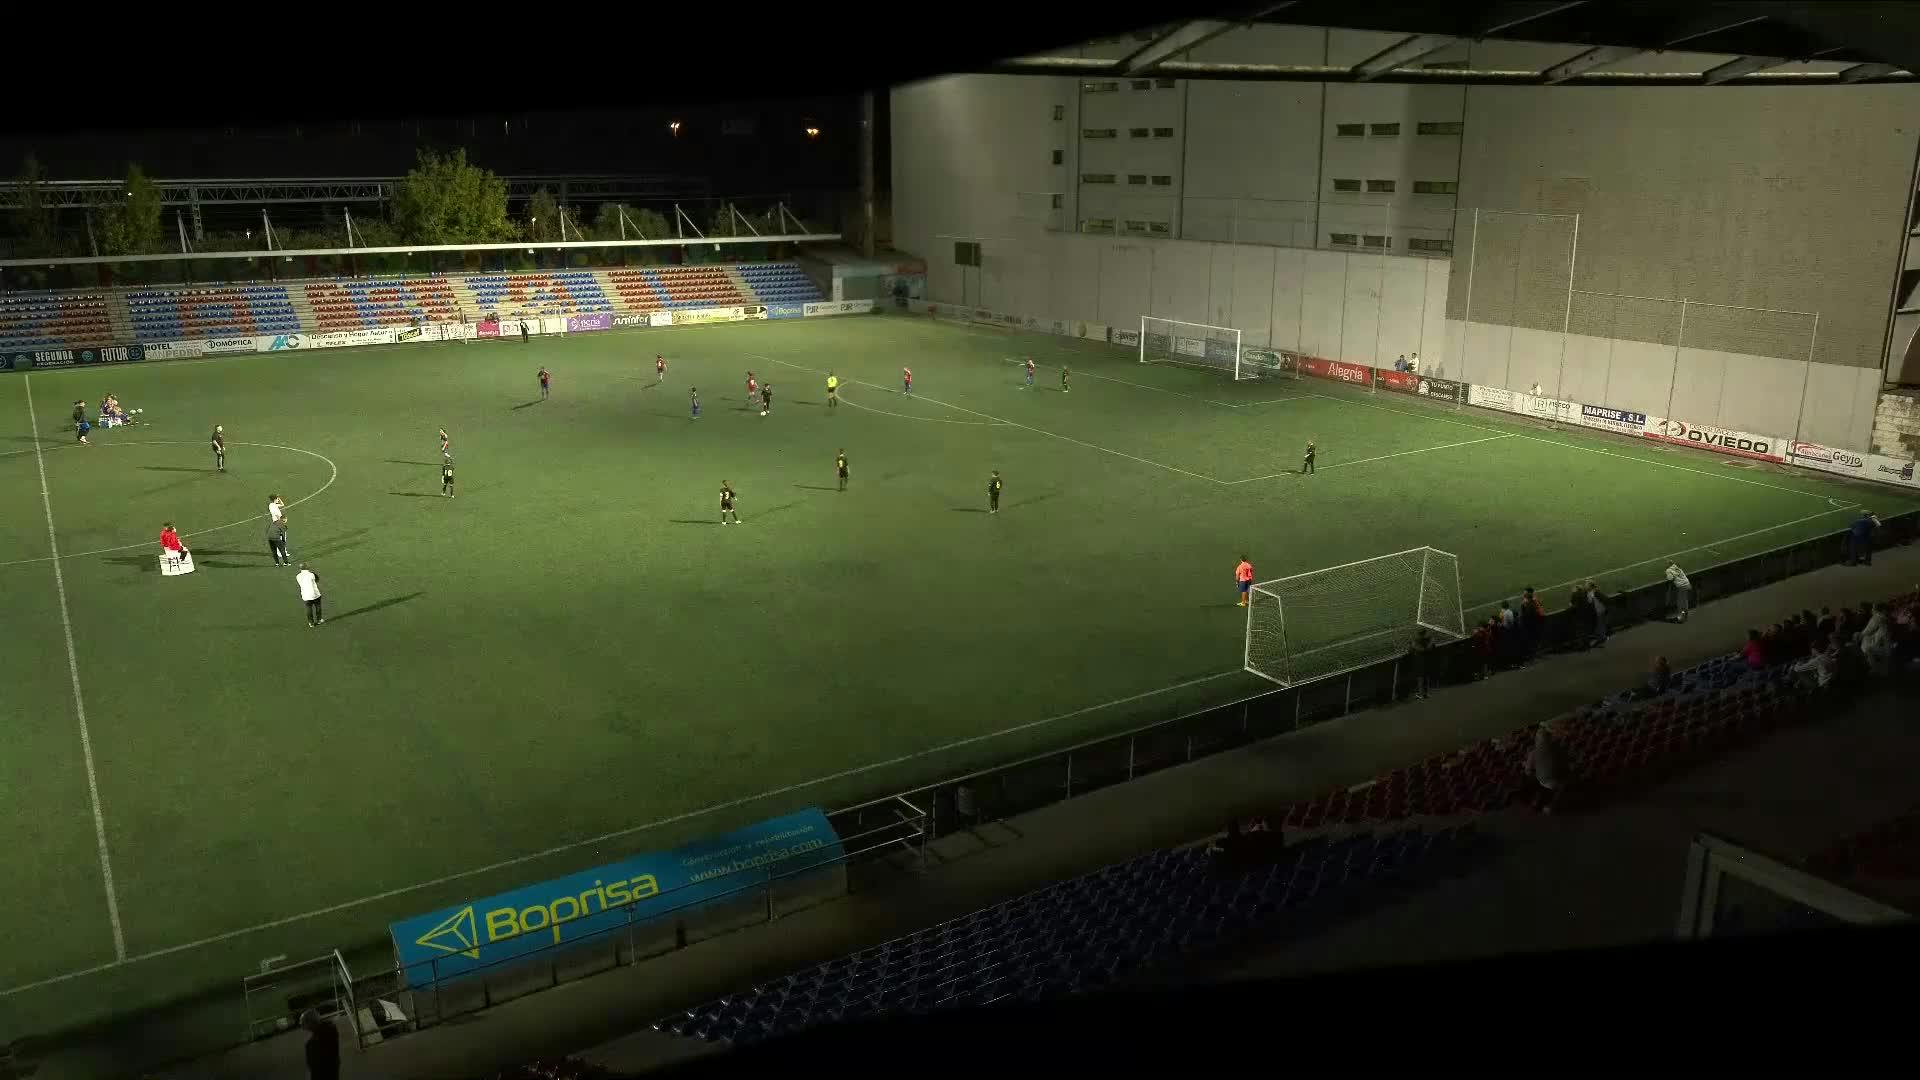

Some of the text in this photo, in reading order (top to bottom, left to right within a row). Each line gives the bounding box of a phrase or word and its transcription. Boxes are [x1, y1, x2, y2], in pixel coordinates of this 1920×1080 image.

[35, 350, 74, 362] SEGUNDA
[144, 343, 172, 352] HOTEL
[1327, 362, 1363, 382] Alegría
[1688, 430, 1769, 455] OVIEDO
[1833, 451, 1861, 465] Geyjo
[486, 873, 659, 945] Boprisa
